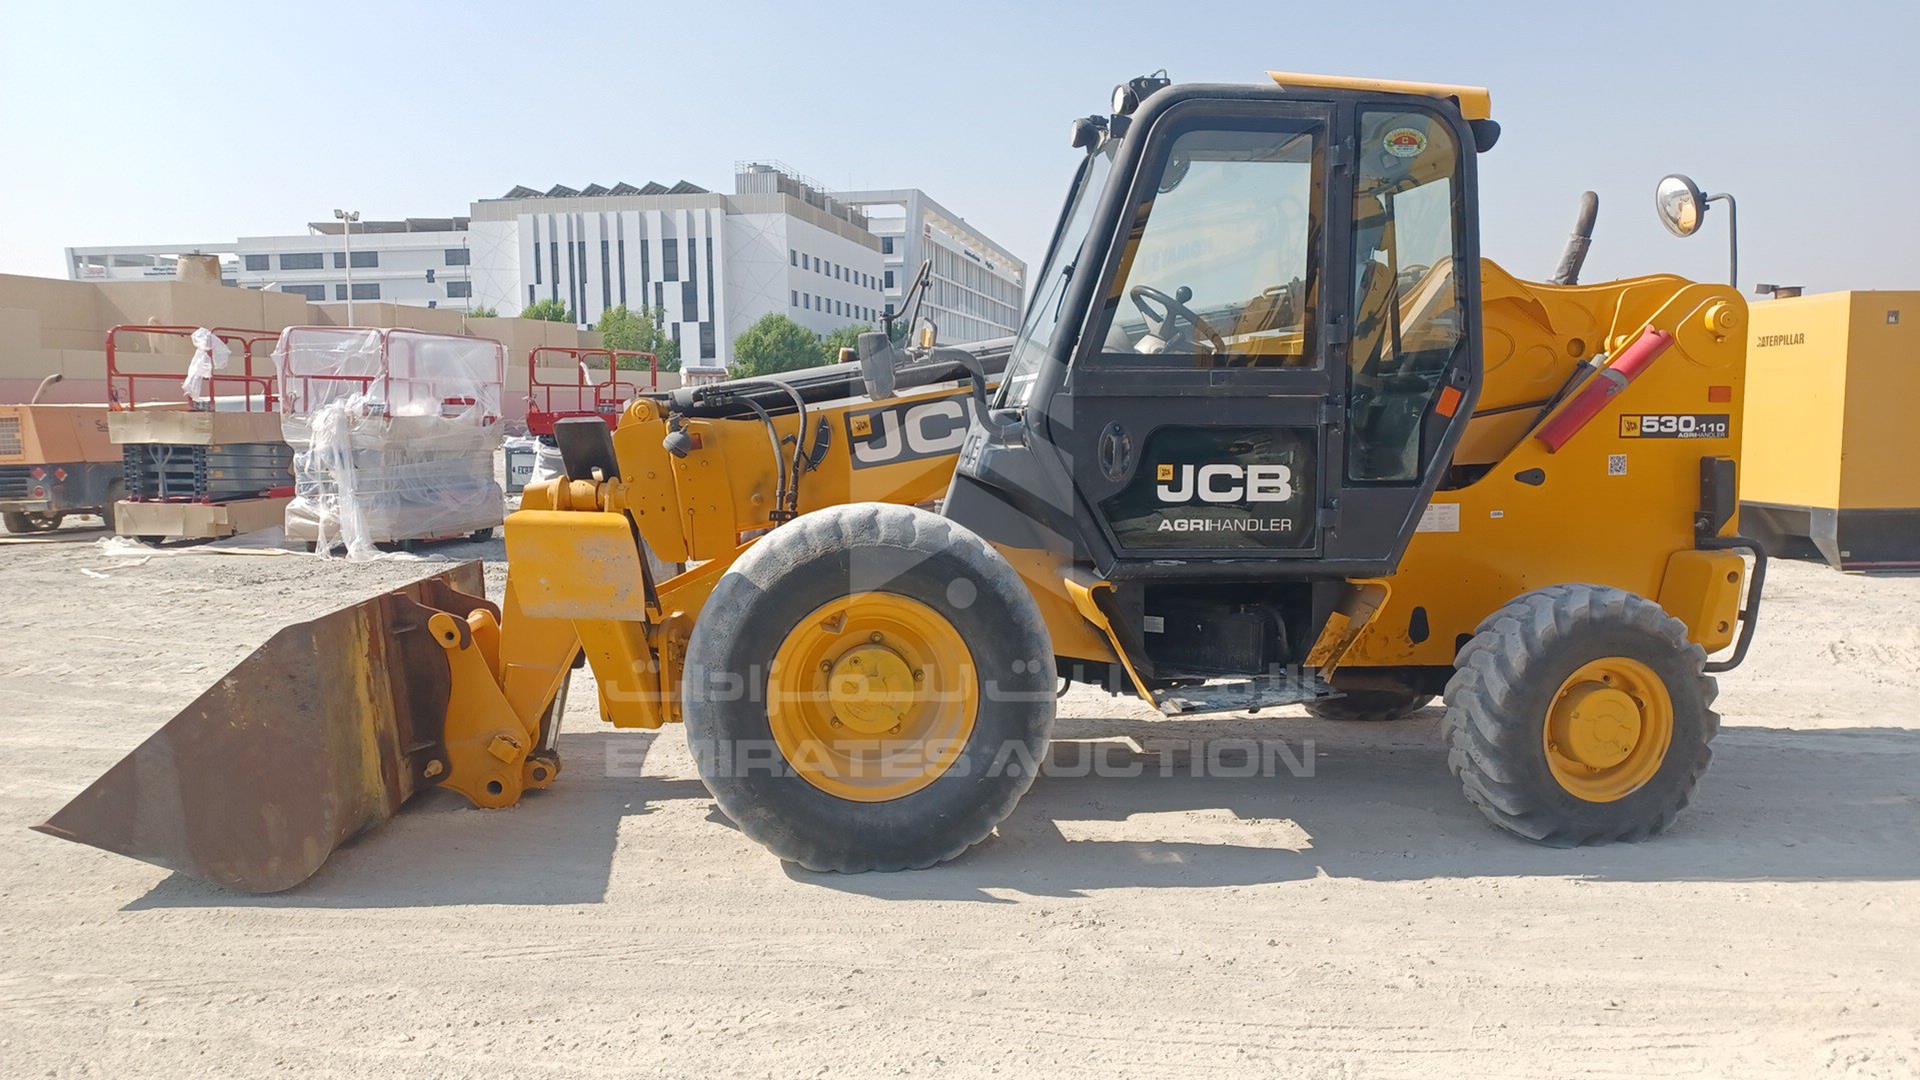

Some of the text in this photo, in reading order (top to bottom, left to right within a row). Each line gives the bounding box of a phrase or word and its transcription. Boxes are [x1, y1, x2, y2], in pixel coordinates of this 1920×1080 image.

[854, 397, 976, 463] JC
[1642, 415, 1726, 433] 530-110
[1157, 464, 1292, 502] JCB
[1157, 518, 1293, 532] AGRIHANDLER
